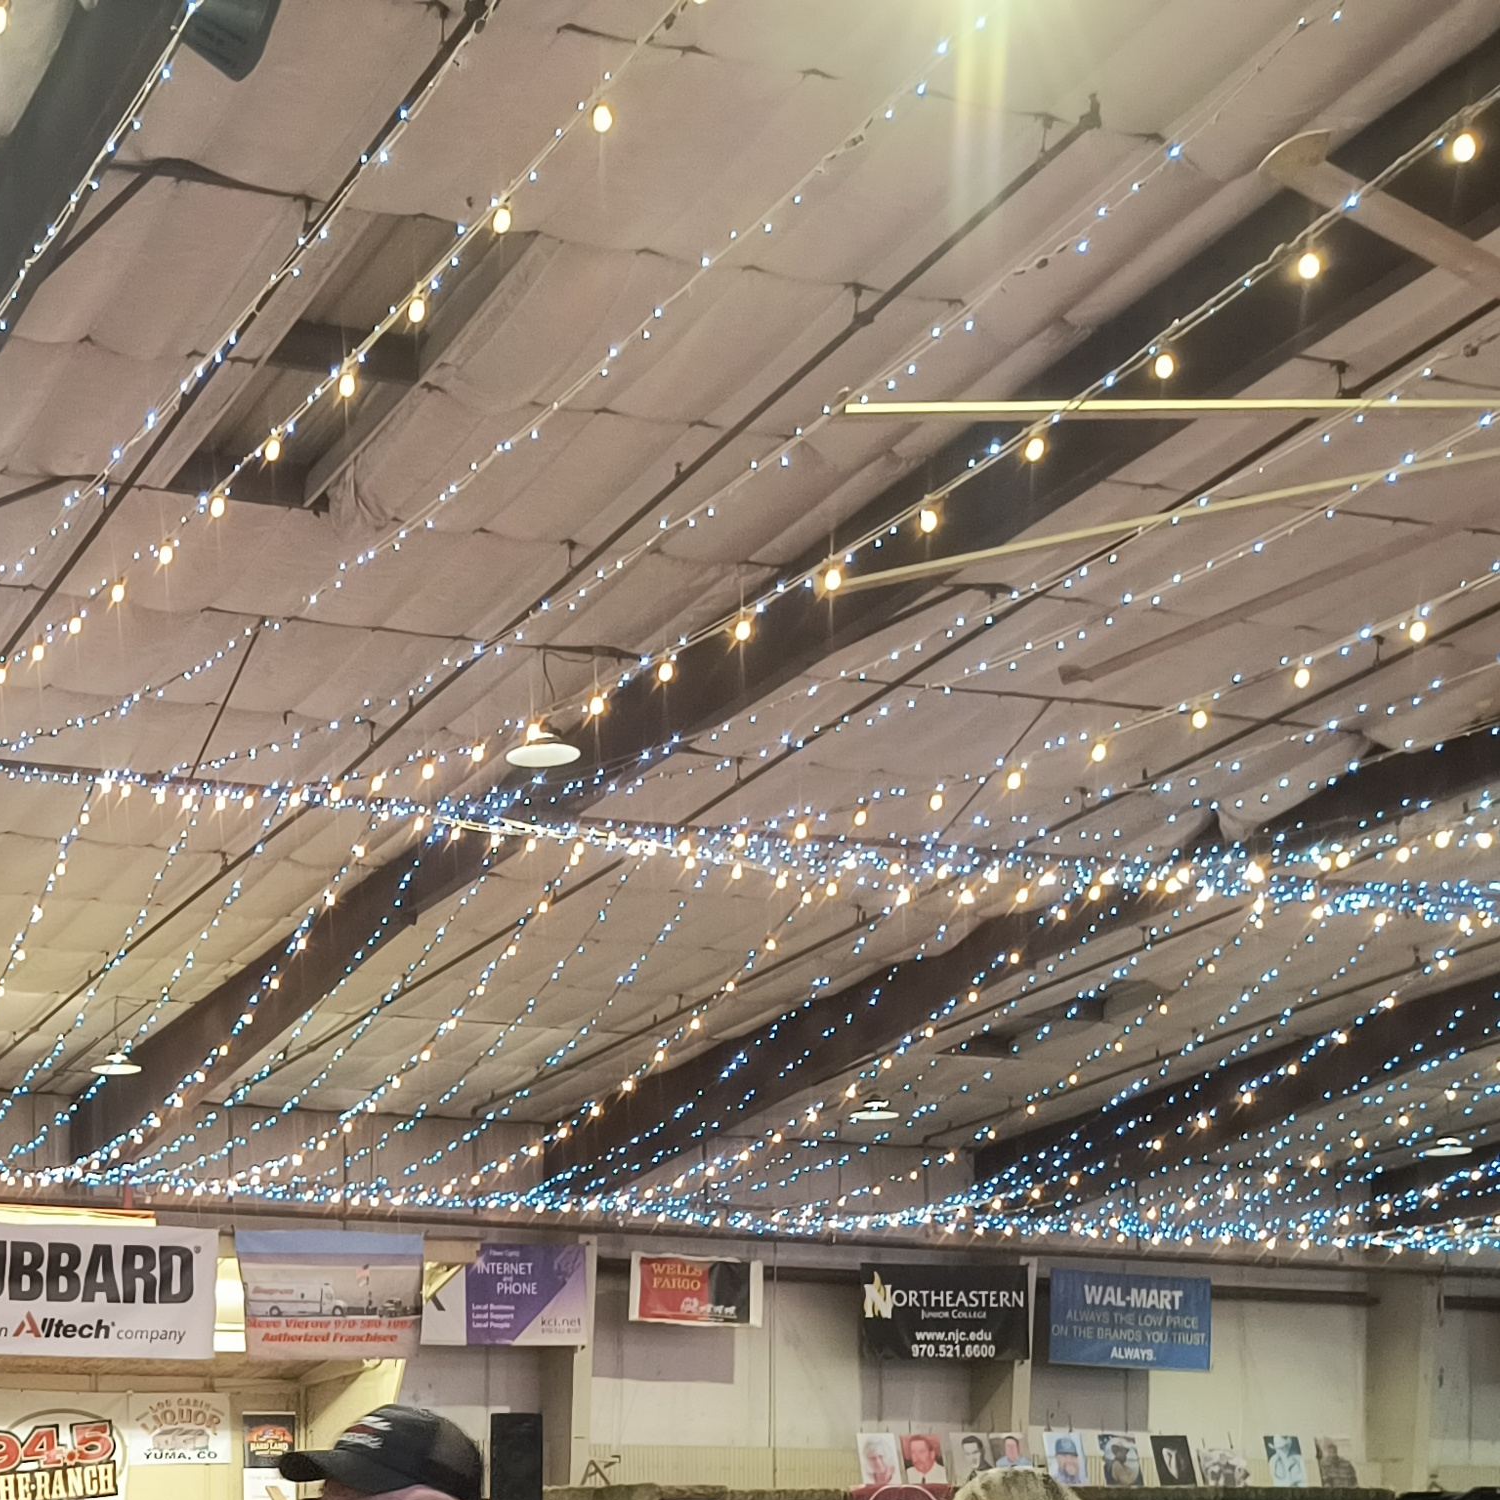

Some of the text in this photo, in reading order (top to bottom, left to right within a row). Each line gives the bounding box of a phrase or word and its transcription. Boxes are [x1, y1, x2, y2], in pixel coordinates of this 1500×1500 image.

[477, 1262, 533, 1275] INTERNET
[652, 1262, 703, 1277] WELLS
[497, 1282, 538, 1295] PHONE
[652, 1277, 701, 1291] FARGO
[863, 1283, 1024, 1319] NORTHEASTERN
[1066, 1308, 1199, 1330] ALWAYS THE LOW PRICE
[12, 1311, 111, 1340] Alltech
[116, 1326, 186, 1345] company
[915, 1328, 993, 1344] www.njc.edu
[1051, 1323, 1068, 1337] ON
[1073, 1325, 1095, 1339] THE
[1097, 1327, 1142, 1343] BRANDS
[1145, 1330, 1168, 1345] YOU
[261, 1331, 398, 1343] Authorized Franchisee
[911, 1343, 996, 1359] 970.521.6600
[140, 1408, 221, 1436] LIQUOR
[197, 1451, 218, 1460] CO
